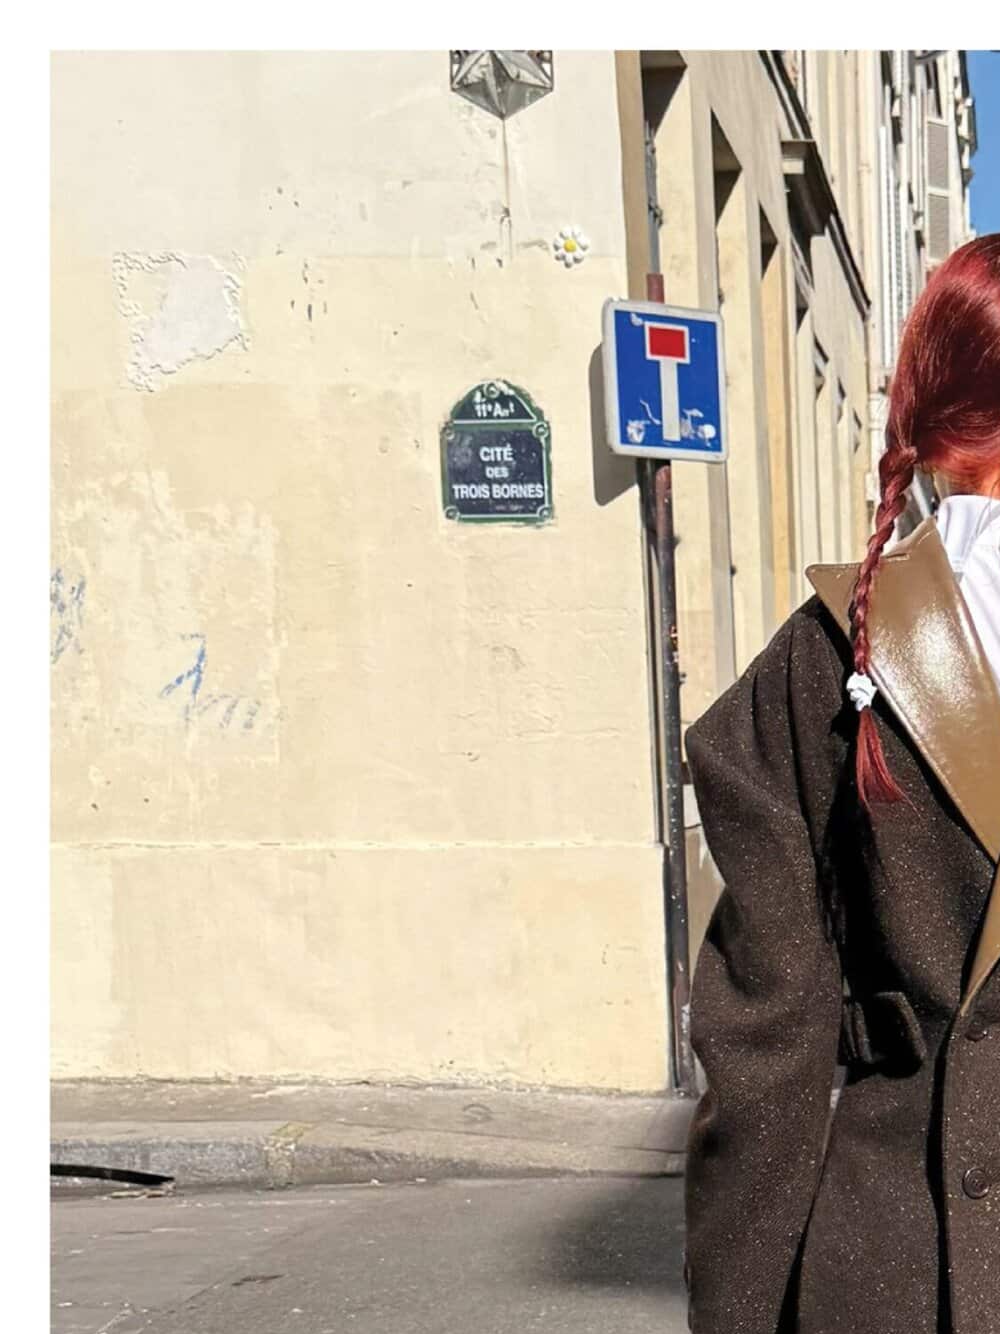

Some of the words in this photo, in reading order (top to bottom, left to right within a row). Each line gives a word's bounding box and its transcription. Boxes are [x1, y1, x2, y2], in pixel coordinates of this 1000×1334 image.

[479, 443, 514, 462] CITÉ
[485, 466, 509, 478] DES
[452, 484, 490, 499] TROIS
[492, 484, 544, 499] BORNES
